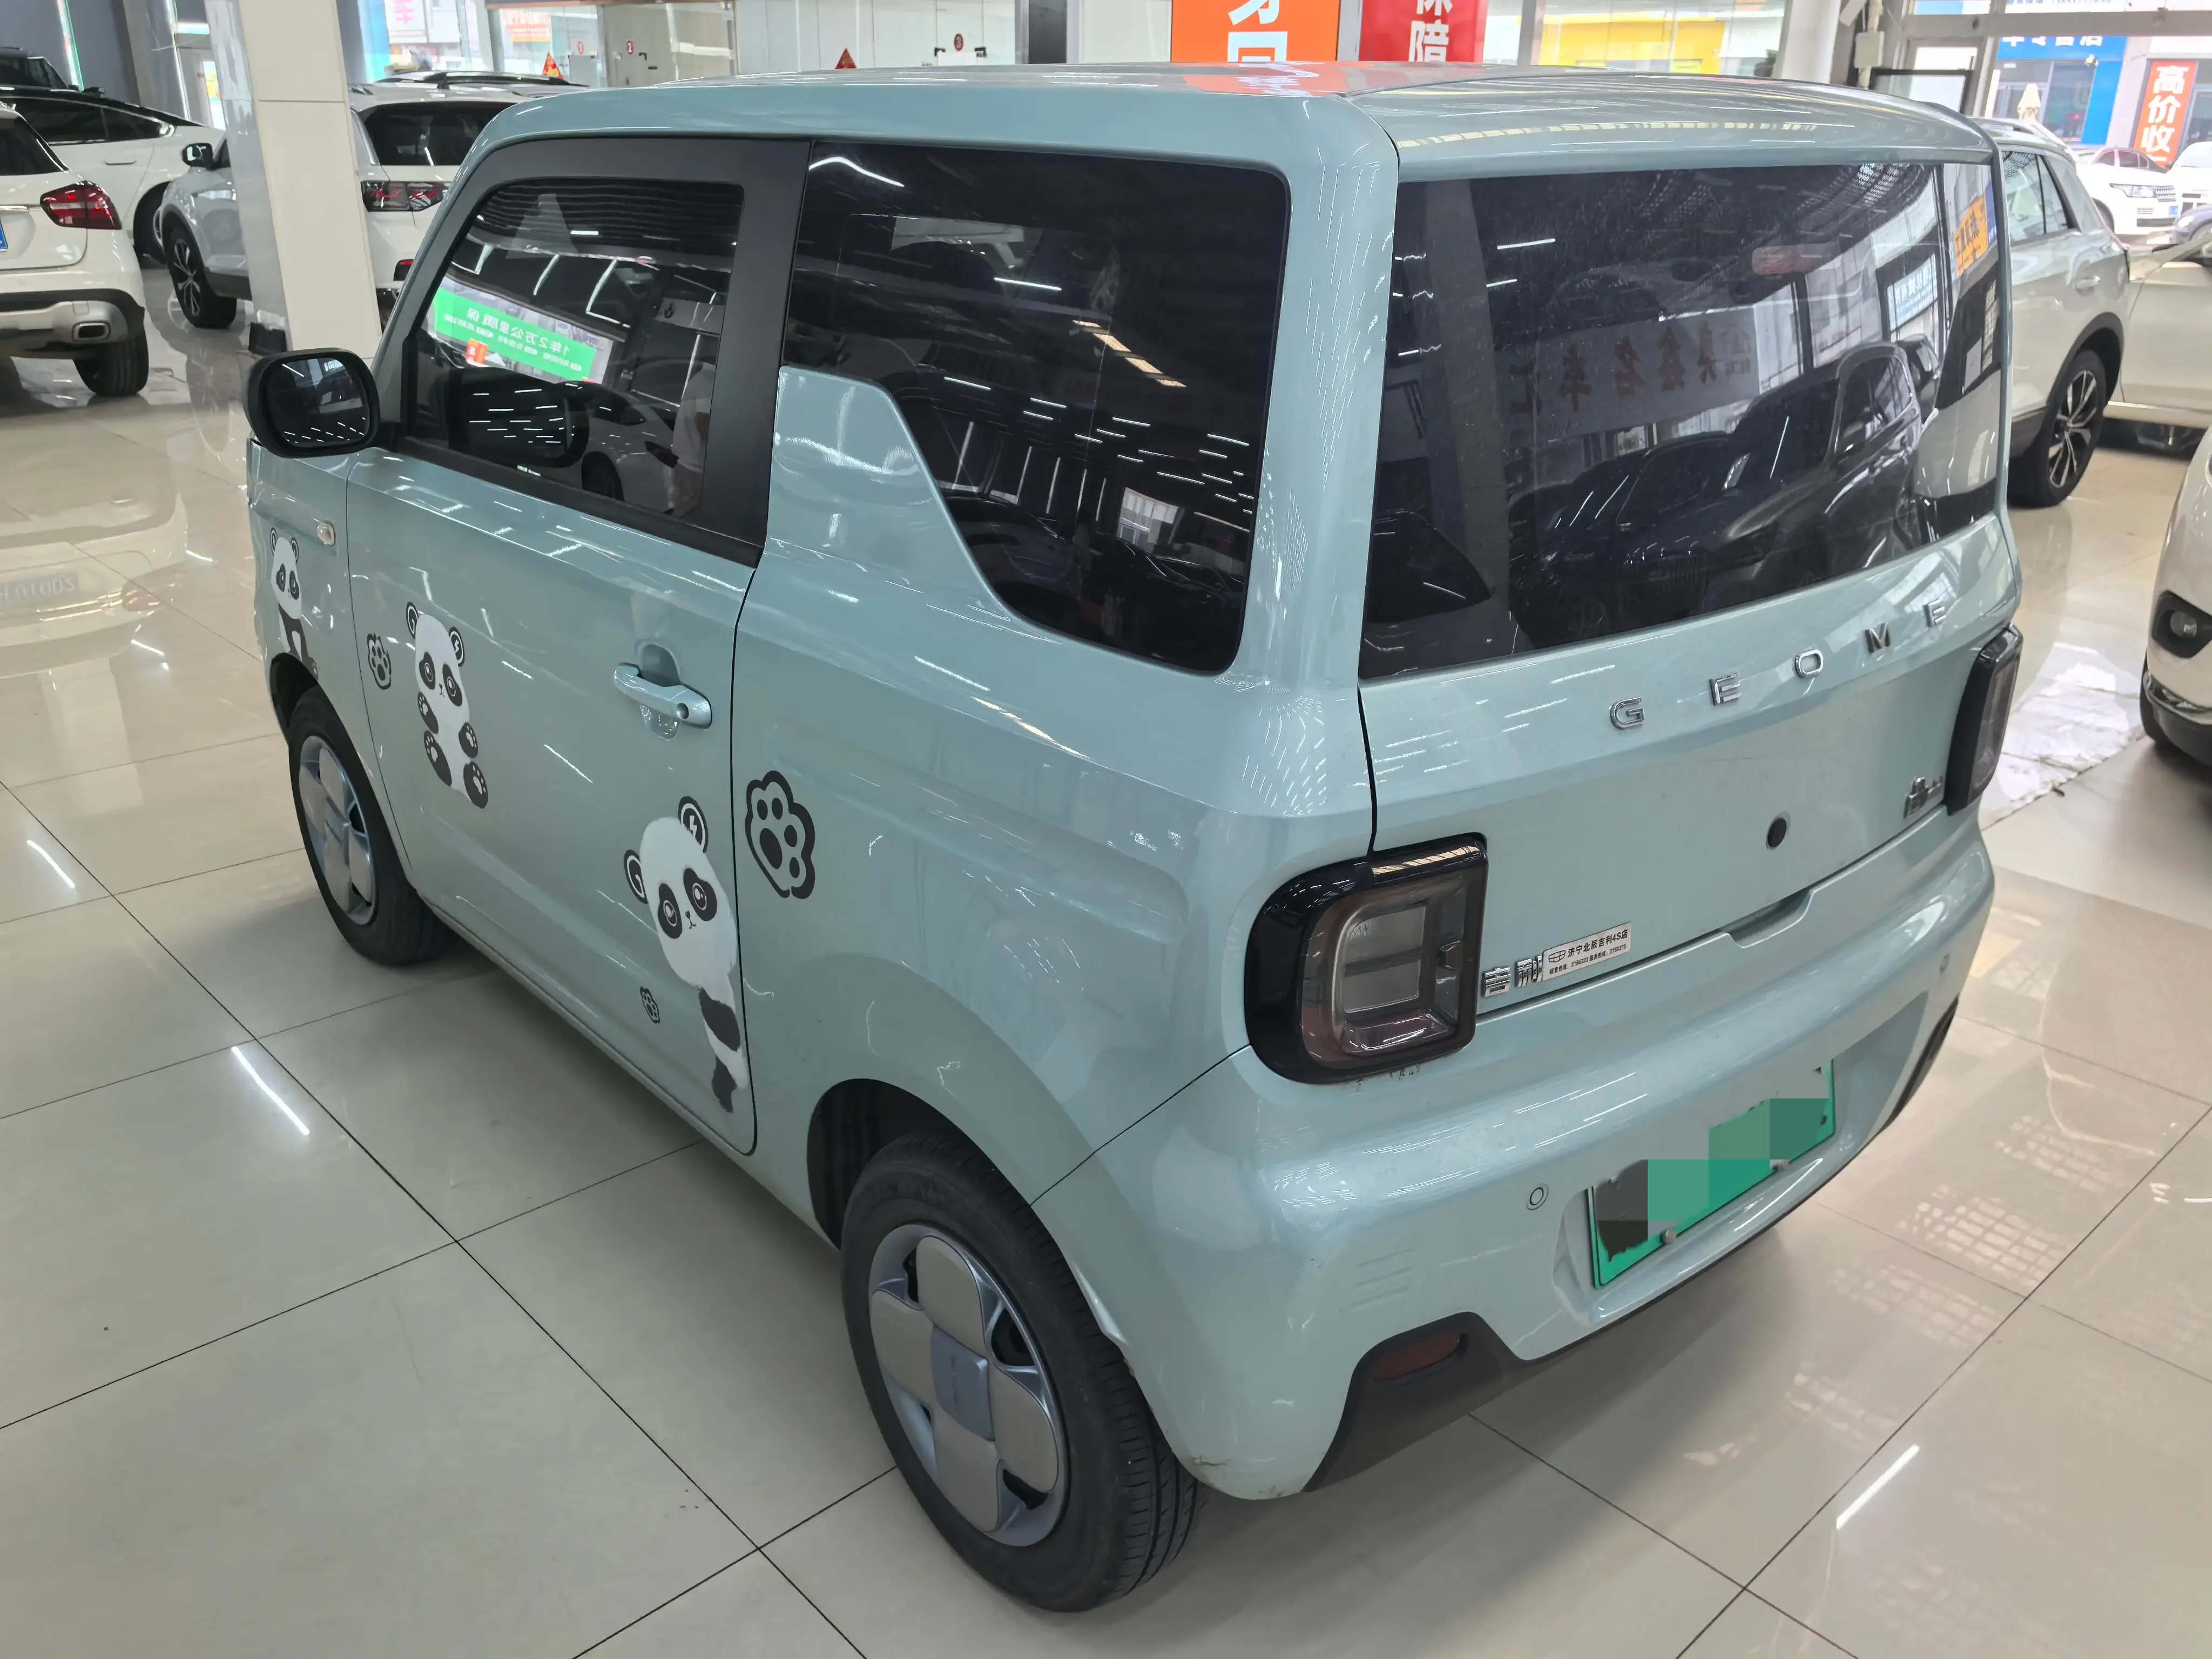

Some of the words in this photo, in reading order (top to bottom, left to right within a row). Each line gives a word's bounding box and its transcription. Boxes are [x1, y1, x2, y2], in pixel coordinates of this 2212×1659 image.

[2141, 65, 2189, 162] 高价收
[1567, 929, 1628, 957] 济宁北辰吉利4S店
